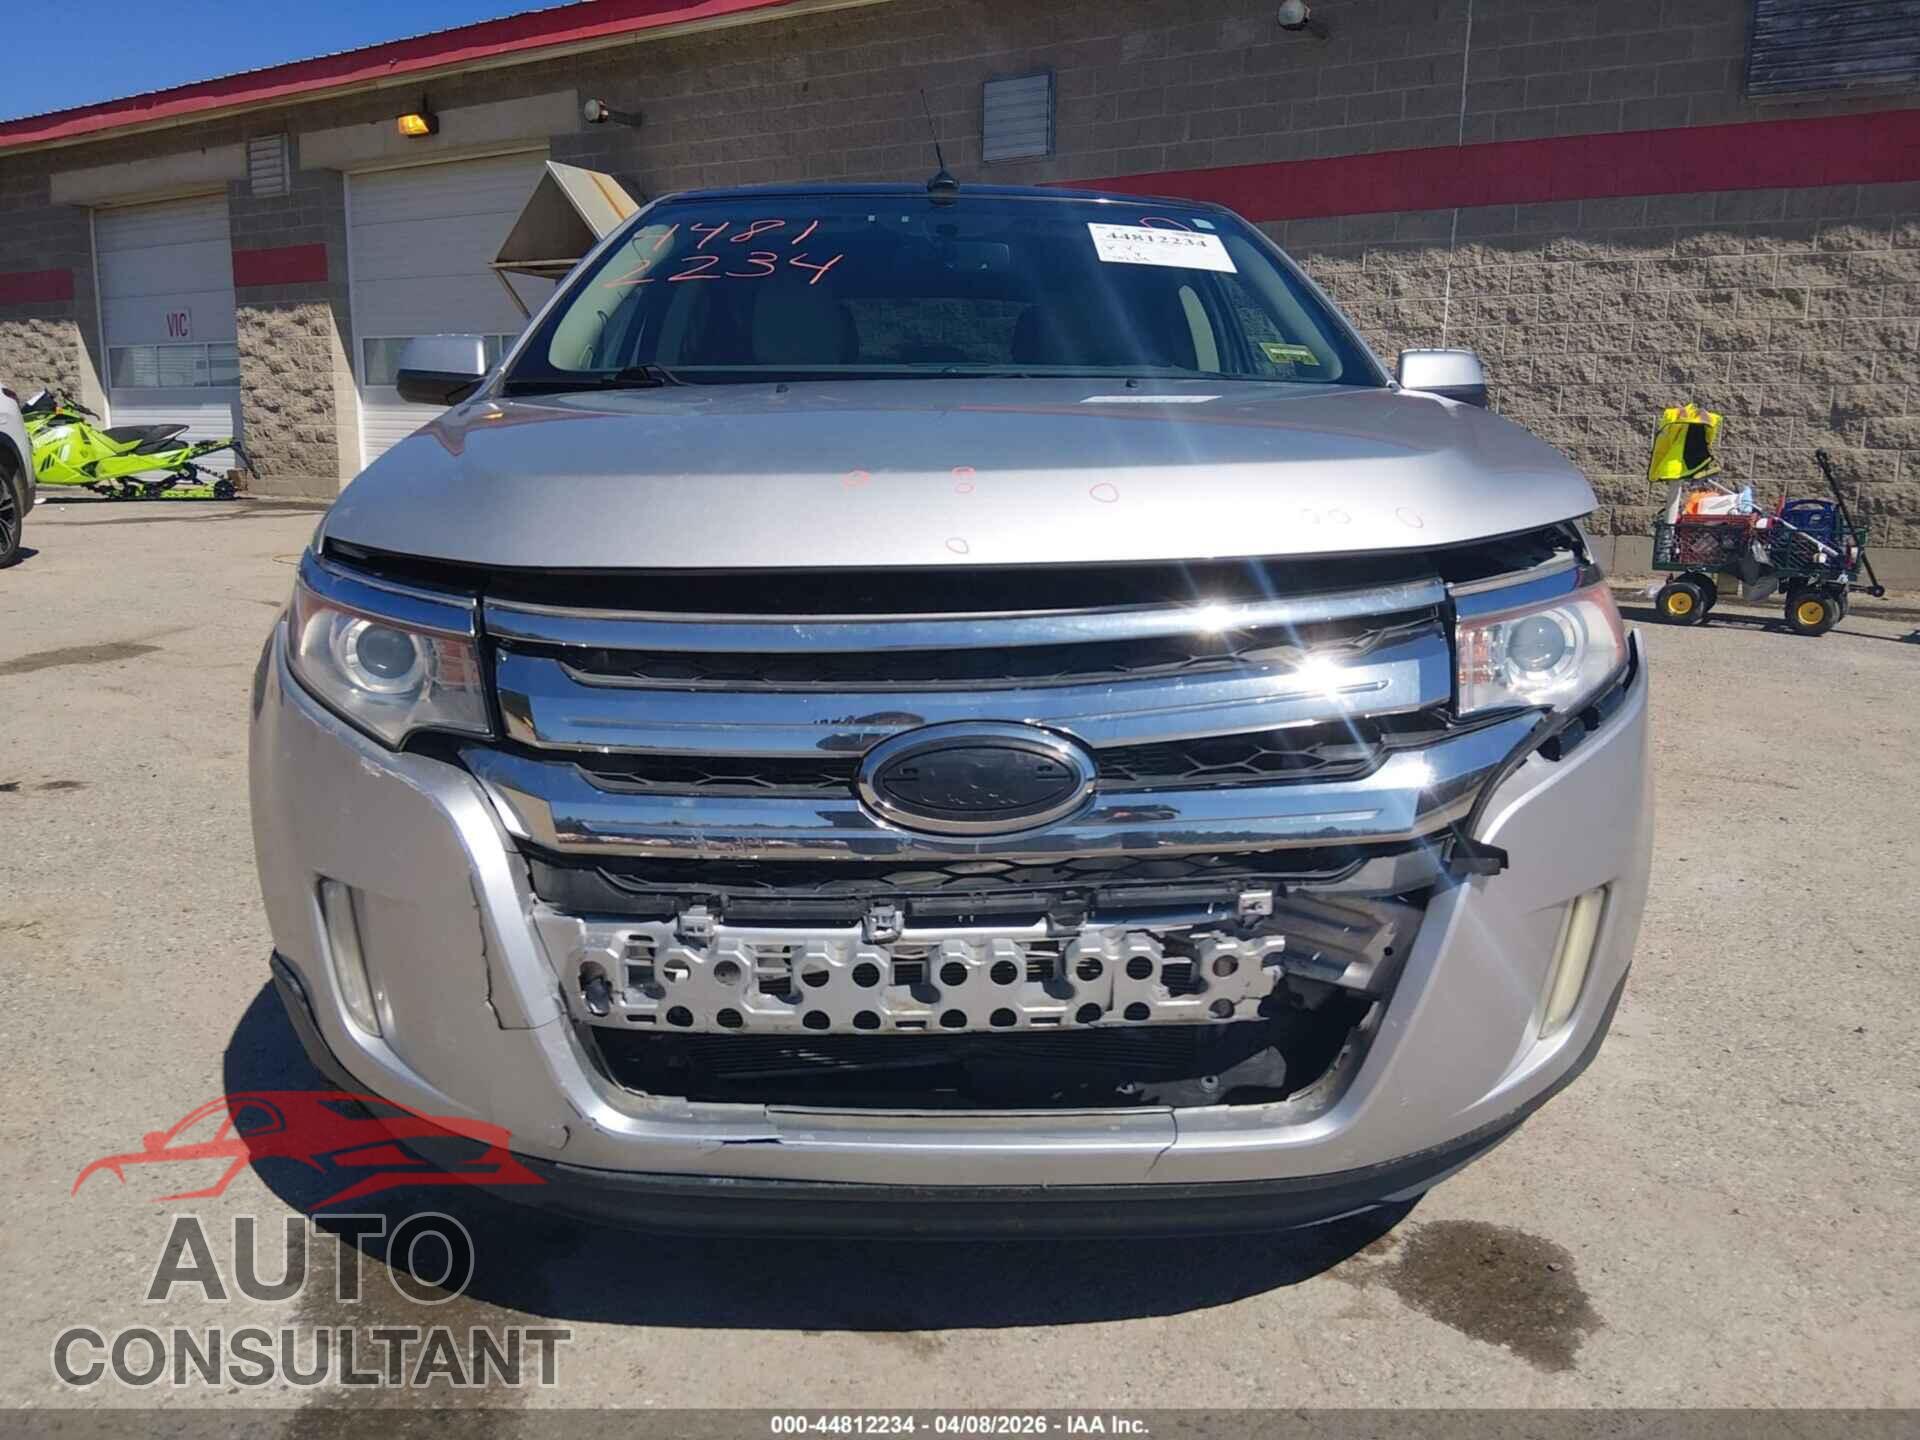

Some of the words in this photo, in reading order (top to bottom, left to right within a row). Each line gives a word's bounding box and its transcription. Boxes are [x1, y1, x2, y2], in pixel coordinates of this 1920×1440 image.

[1105, 231, 1208, 249] 44812234
[602, 251, 844, 286] 2234
[166, 312, 189, 337] VIC
